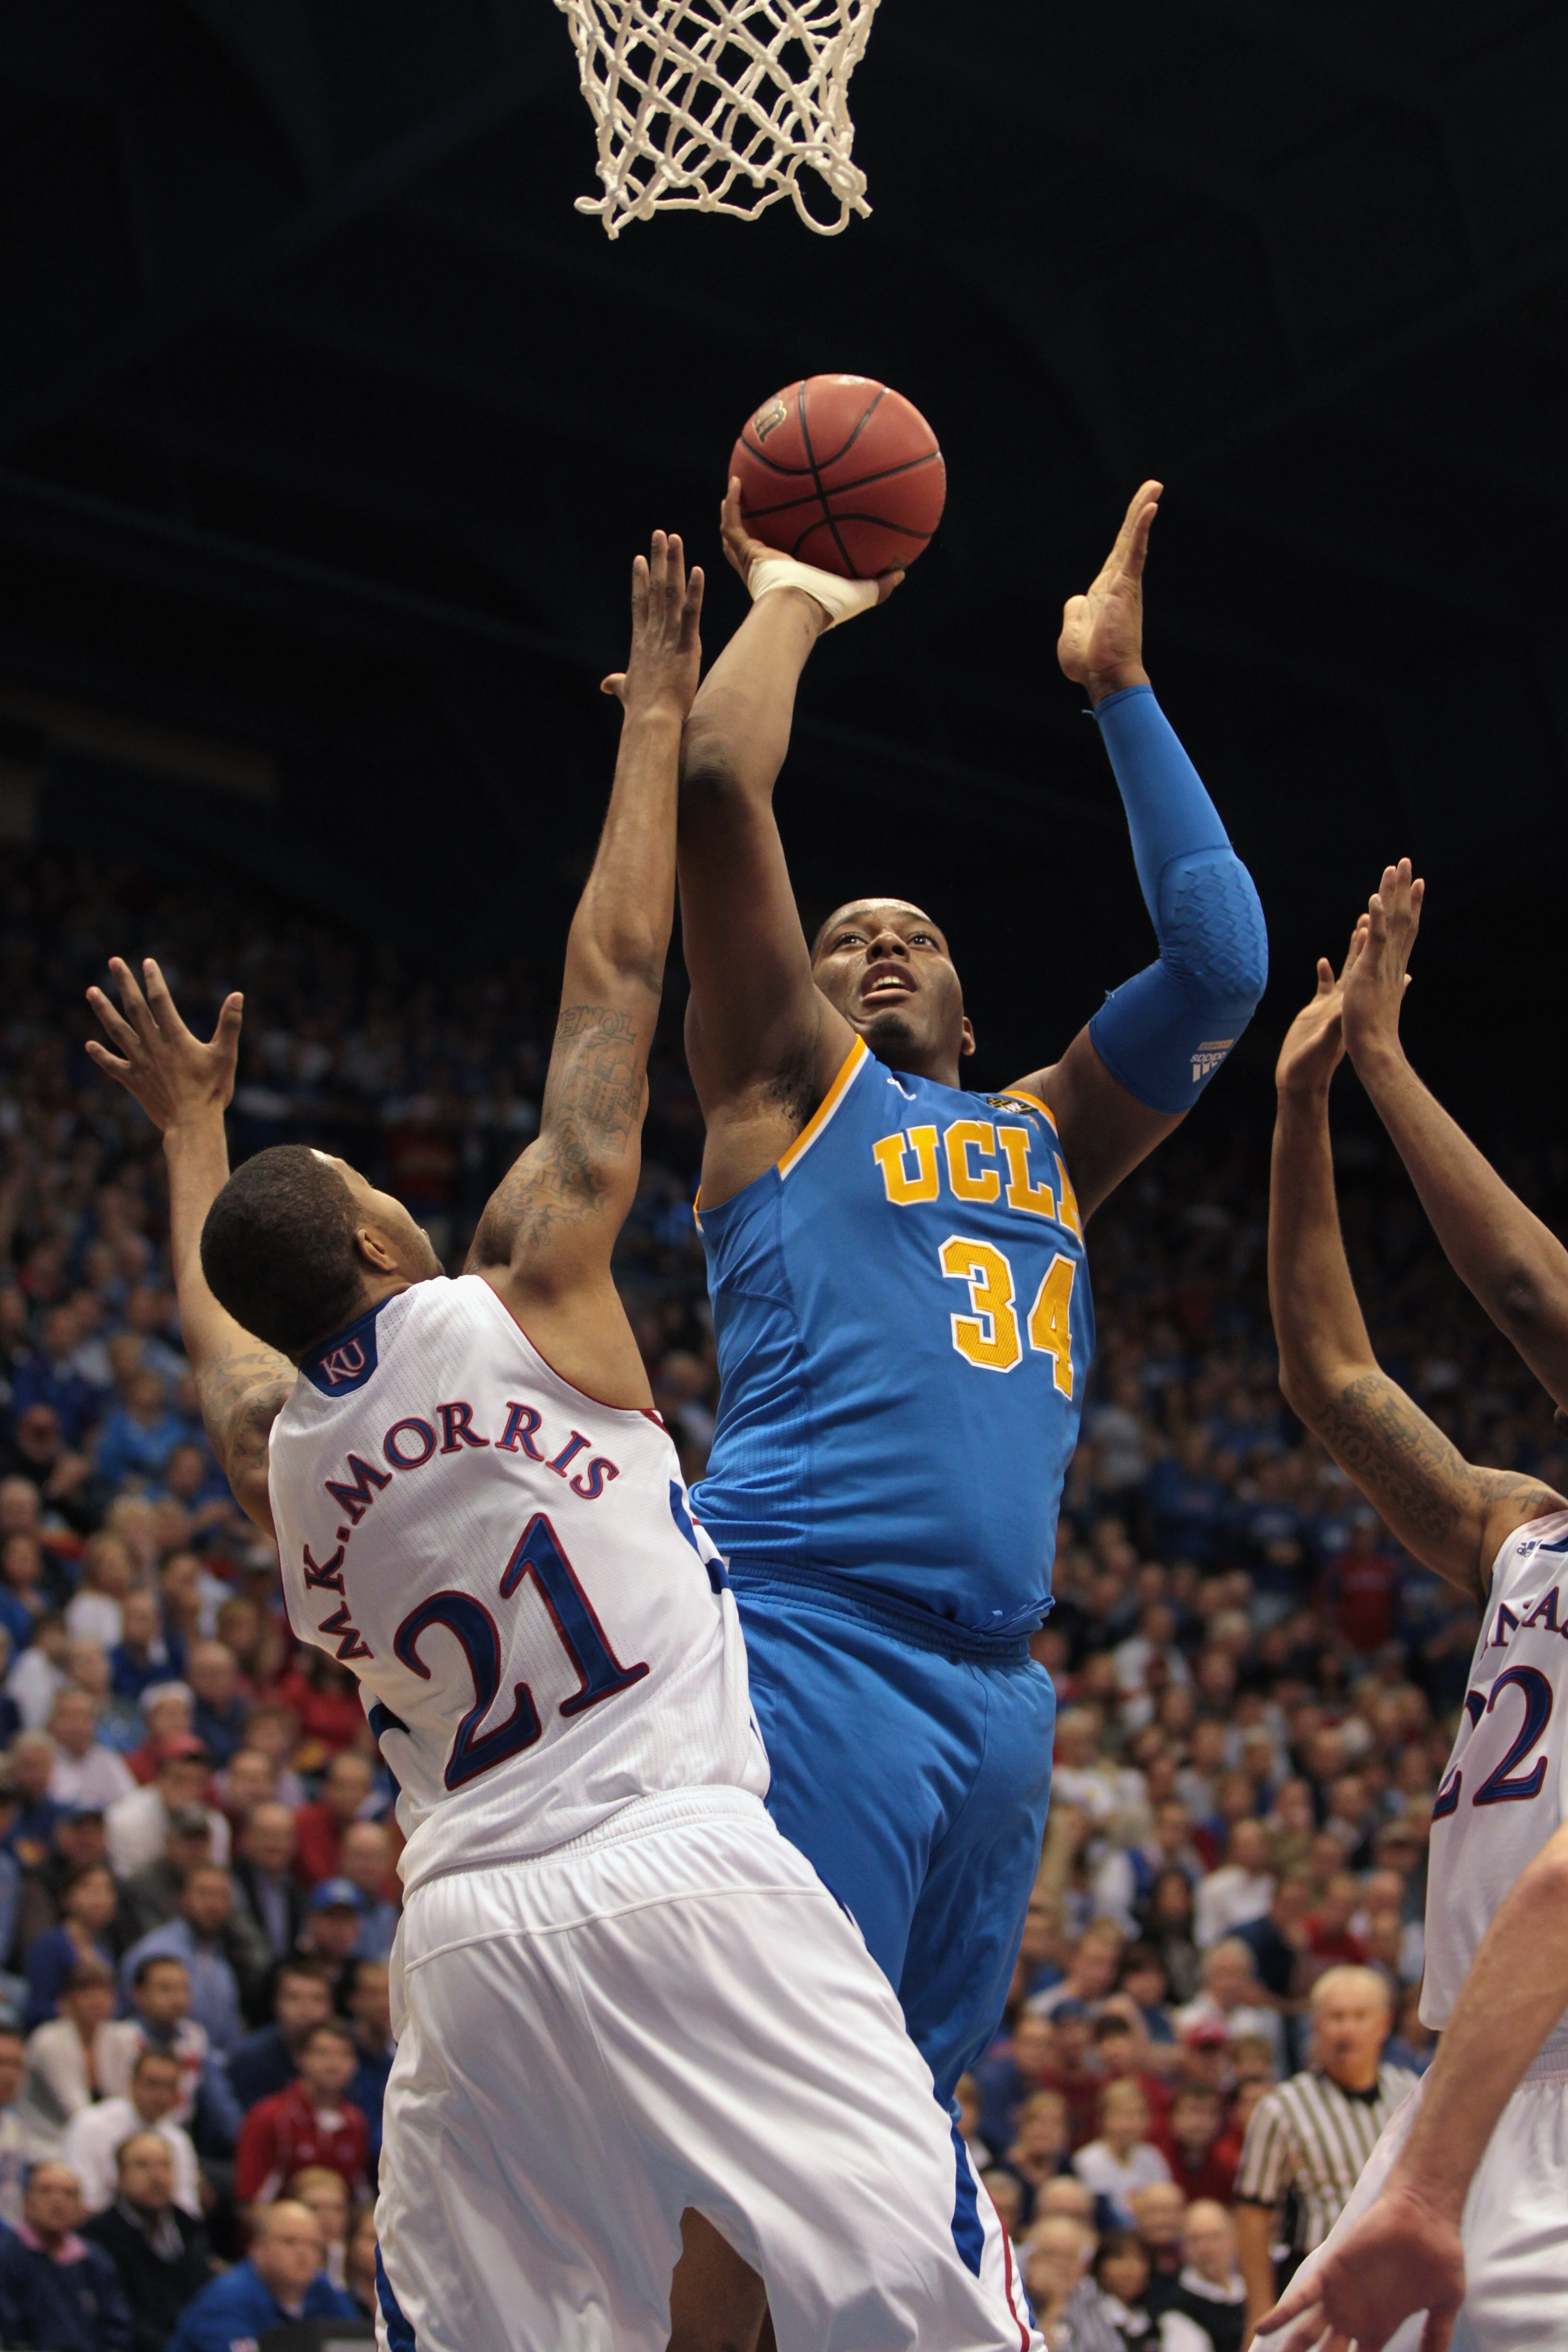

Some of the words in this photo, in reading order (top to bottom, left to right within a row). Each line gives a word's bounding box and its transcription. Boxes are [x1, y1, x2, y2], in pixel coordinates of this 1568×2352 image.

[319, 1337, 366, 1386] KU
[938, 1235, 1076, 1402] 34
[393, 1512, 649, 1790] 21
